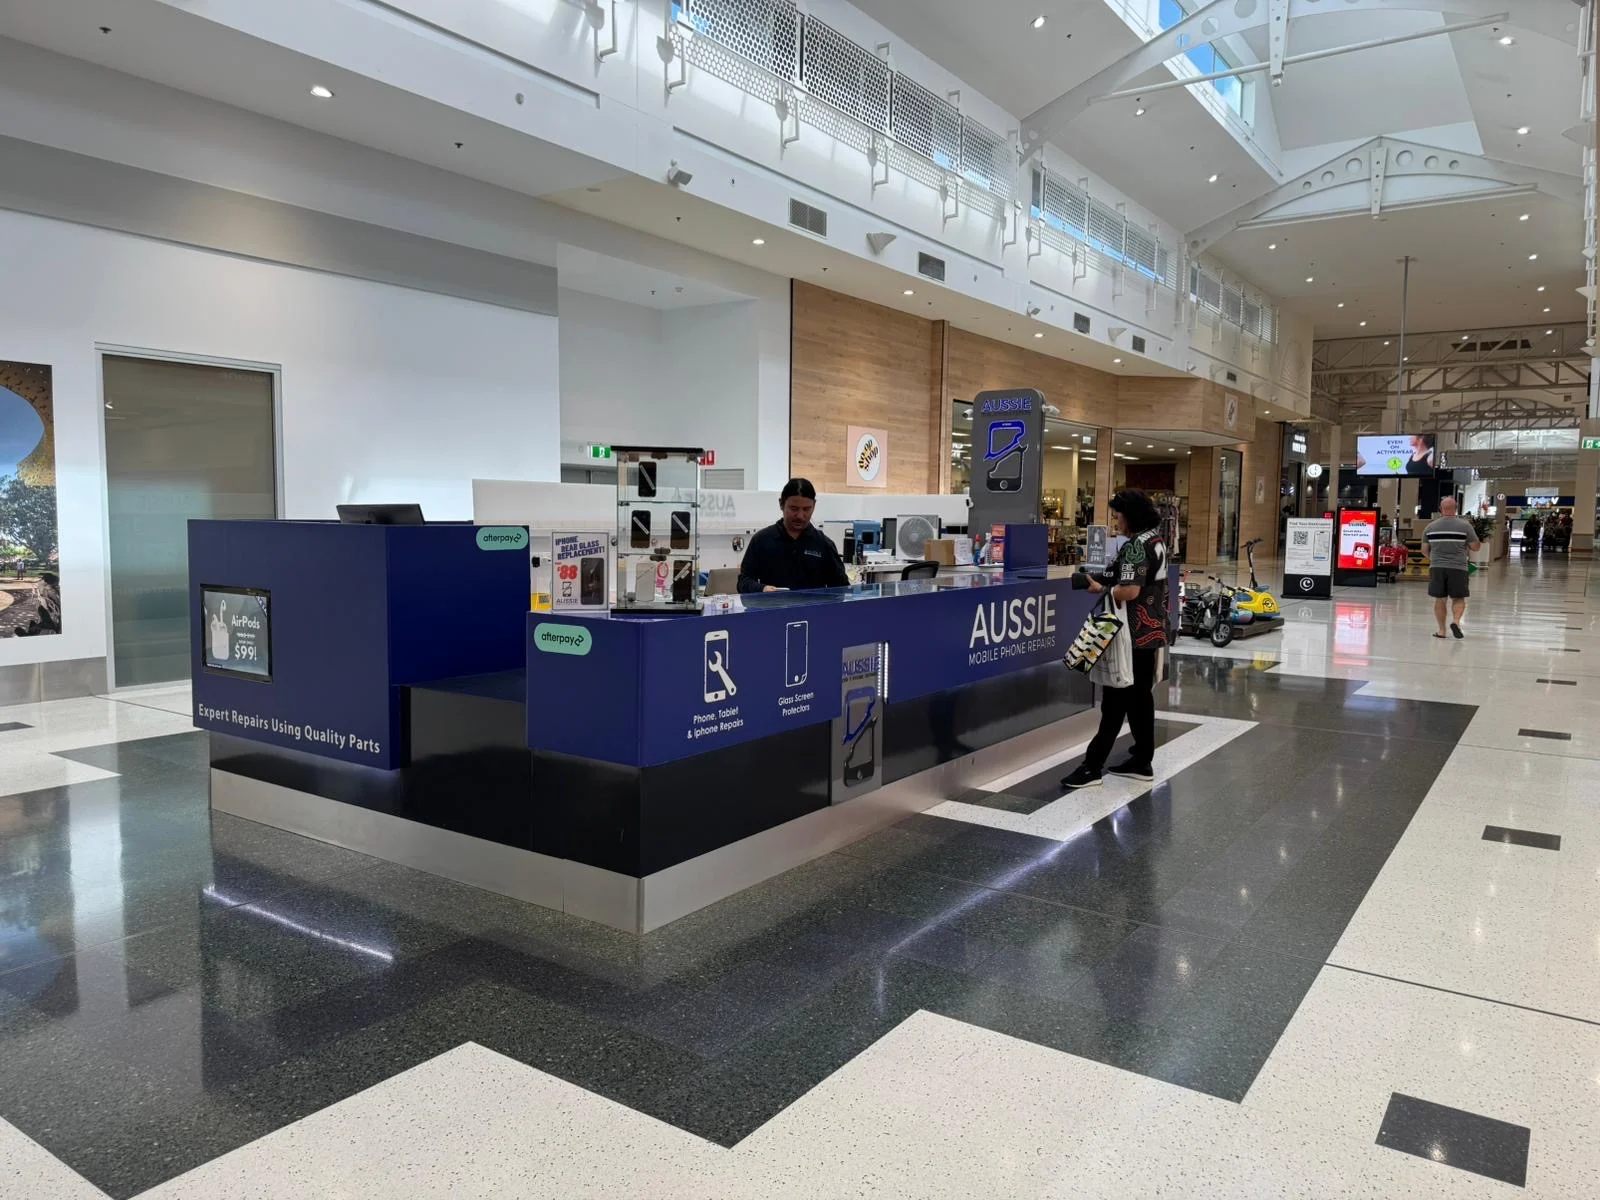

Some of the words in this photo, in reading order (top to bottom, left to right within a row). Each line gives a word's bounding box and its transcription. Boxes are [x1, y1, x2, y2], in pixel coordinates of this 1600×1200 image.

[982, 396, 1032, 412] AUSSIE
[483, 534, 513, 543] afterpay
[555, 536, 578, 546] IPHONE
[558, 546, 605, 560] REPLACEMENT!
[561, 544, 578, 552] REAR
[579, 540, 600, 549] GLASS
[231, 615, 260, 629] AirPods
[969, 593, 1057, 649] AUSSIE
[541, 632, 575, 646] afterpay
[235, 643, 257, 661] $99!
[968, 647, 999, 667] MOBILE
[1000, 641, 1027, 659] PHONE
[1028, 635, 1056, 653] REPAIRS
[778, 697, 794, 706] Glass
[794, 692, 814, 703] Screen
[718, 706, 739, 720] Tablet
[782, 704, 810, 717] Protectors
[198, 703, 230, 722] Expert
[231, 710, 270, 730] Repairs
[271, 718, 302, 741] Using
[304, 725, 346, 749] Quality
[349, 734, 381, 754] Parts
[687, 730, 693, 739] &
[719, 718, 744, 732] Repairs
